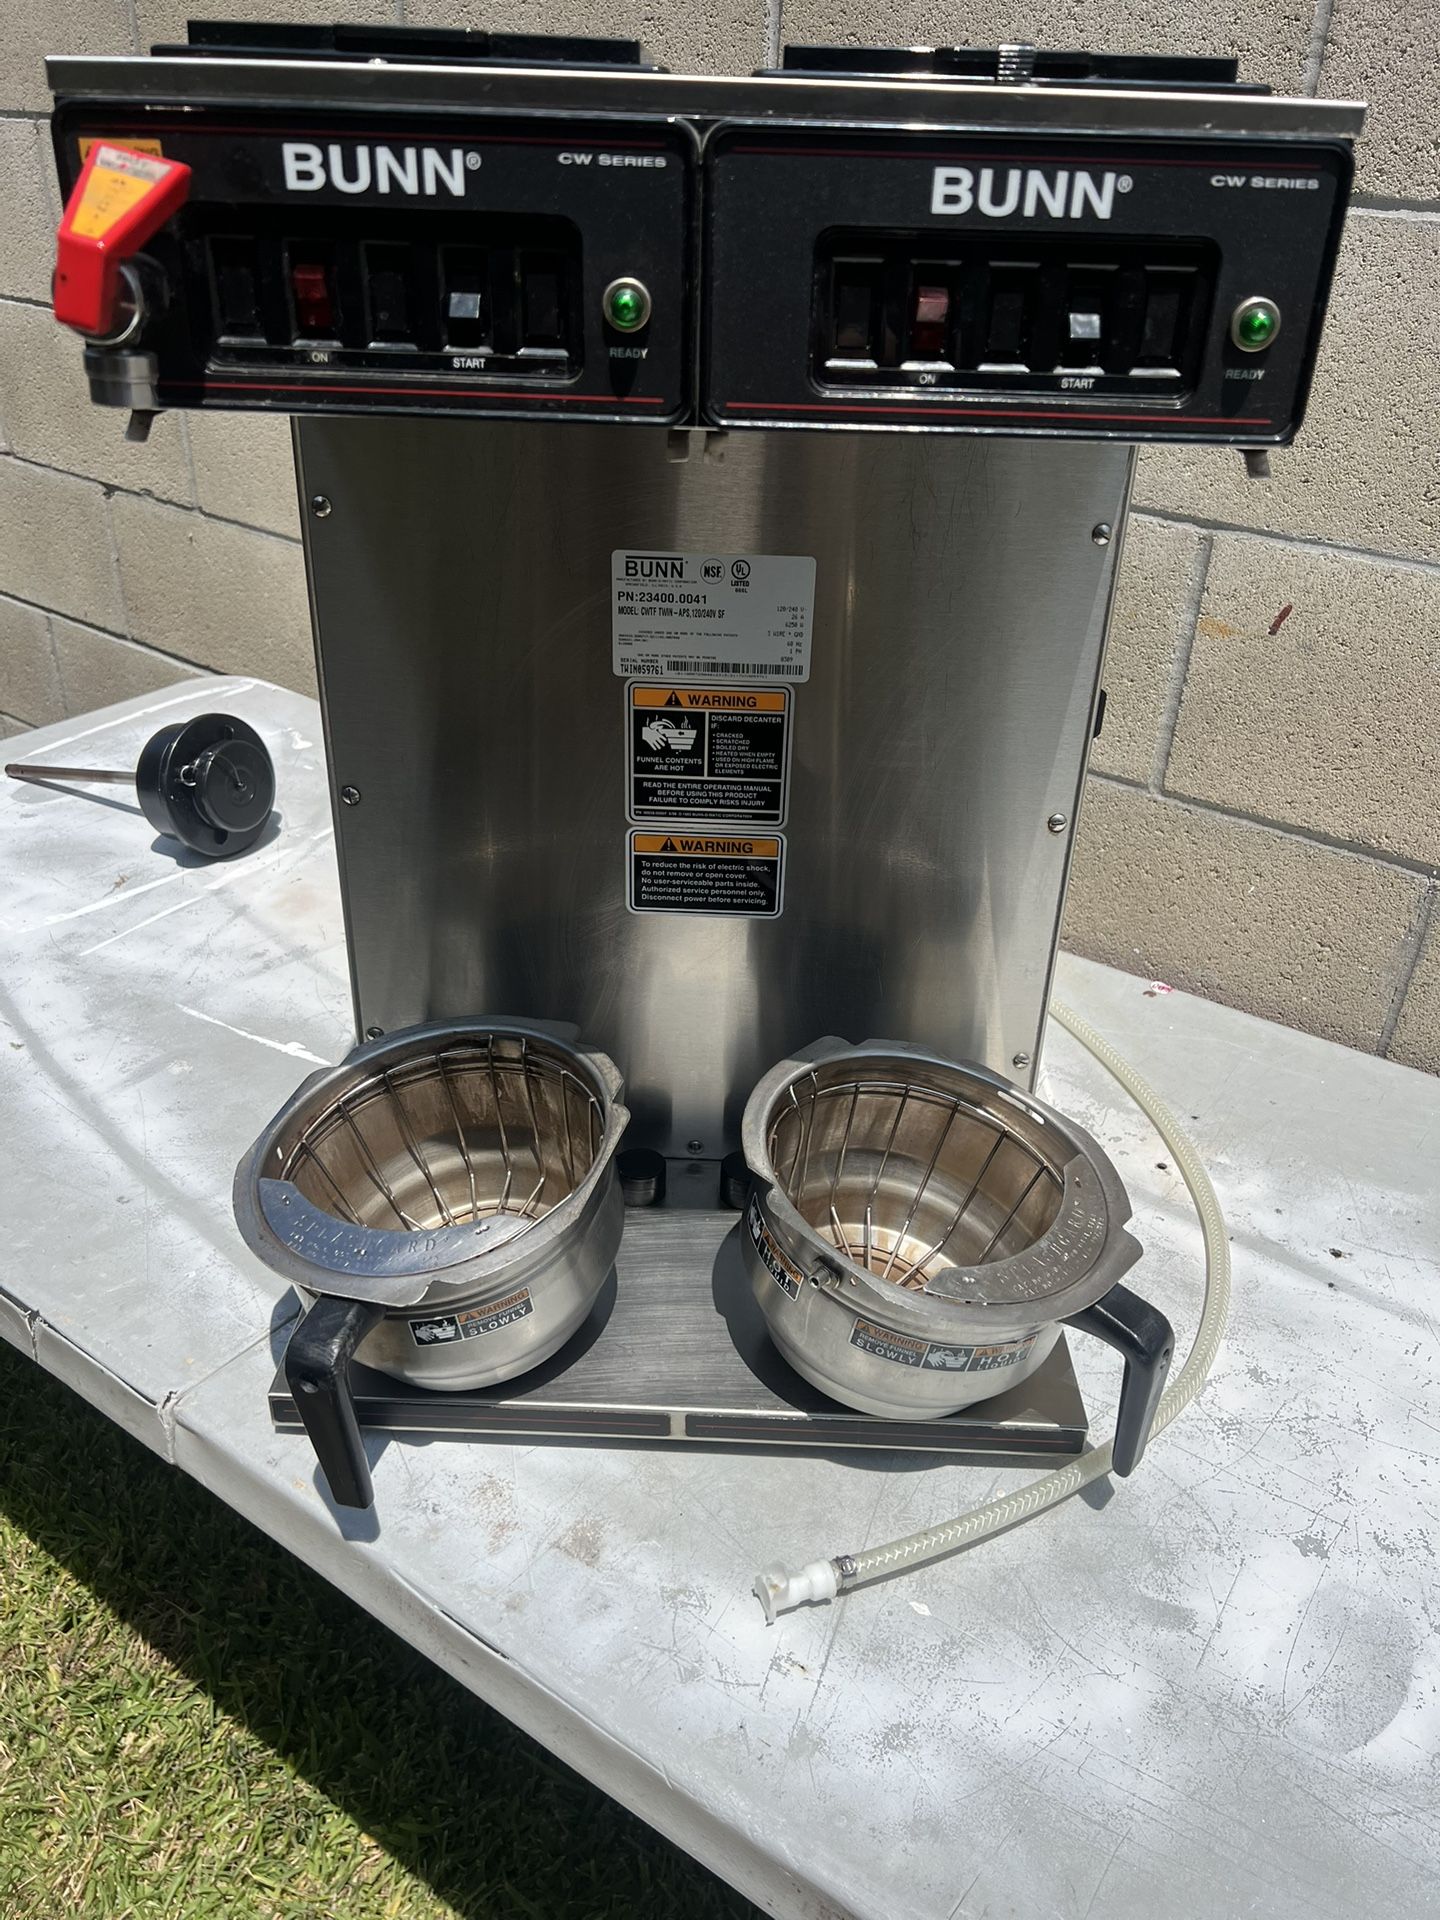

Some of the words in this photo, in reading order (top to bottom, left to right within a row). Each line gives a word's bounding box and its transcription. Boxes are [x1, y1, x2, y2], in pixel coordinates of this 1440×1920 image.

[558, 152, 593, 165] CW
[598, 153, 667, 168] SERIES
[1210, 175, 1246, 187] CW
[1251, 176, 1319, 189] SERIES
[311, 352, 329, 363] ON
[609, 347, 649, 359] READY
[453, 358, 486, 369] START
[919, 374, 936, 385] ON
[1225, 369, 1265, 380] READY
[1061, 378, 1095, 389] START
[688, 694, 757, 707] WARNING
[680, 840, 753, 853] WARNING
[642, 885, 681, 893] Authorized
[654, 878, 713, 887] user-serviceable
[715, 880, 734, 888] parts
[733, 897, 768, 906] servicing.
[477, 1293, 524, 1316] WARNING
[469, 1307, 527, 1336] SLOWLY
[859, 1332, 888, 1347] REMOVE
[889, 1343, 916, 1357] FUNNEL
[874, 1328, 922, 1349] WARNING
[856, 1338, 917, 1365] SLOWLY
[980, 1350, 1022, 1365] HOT
